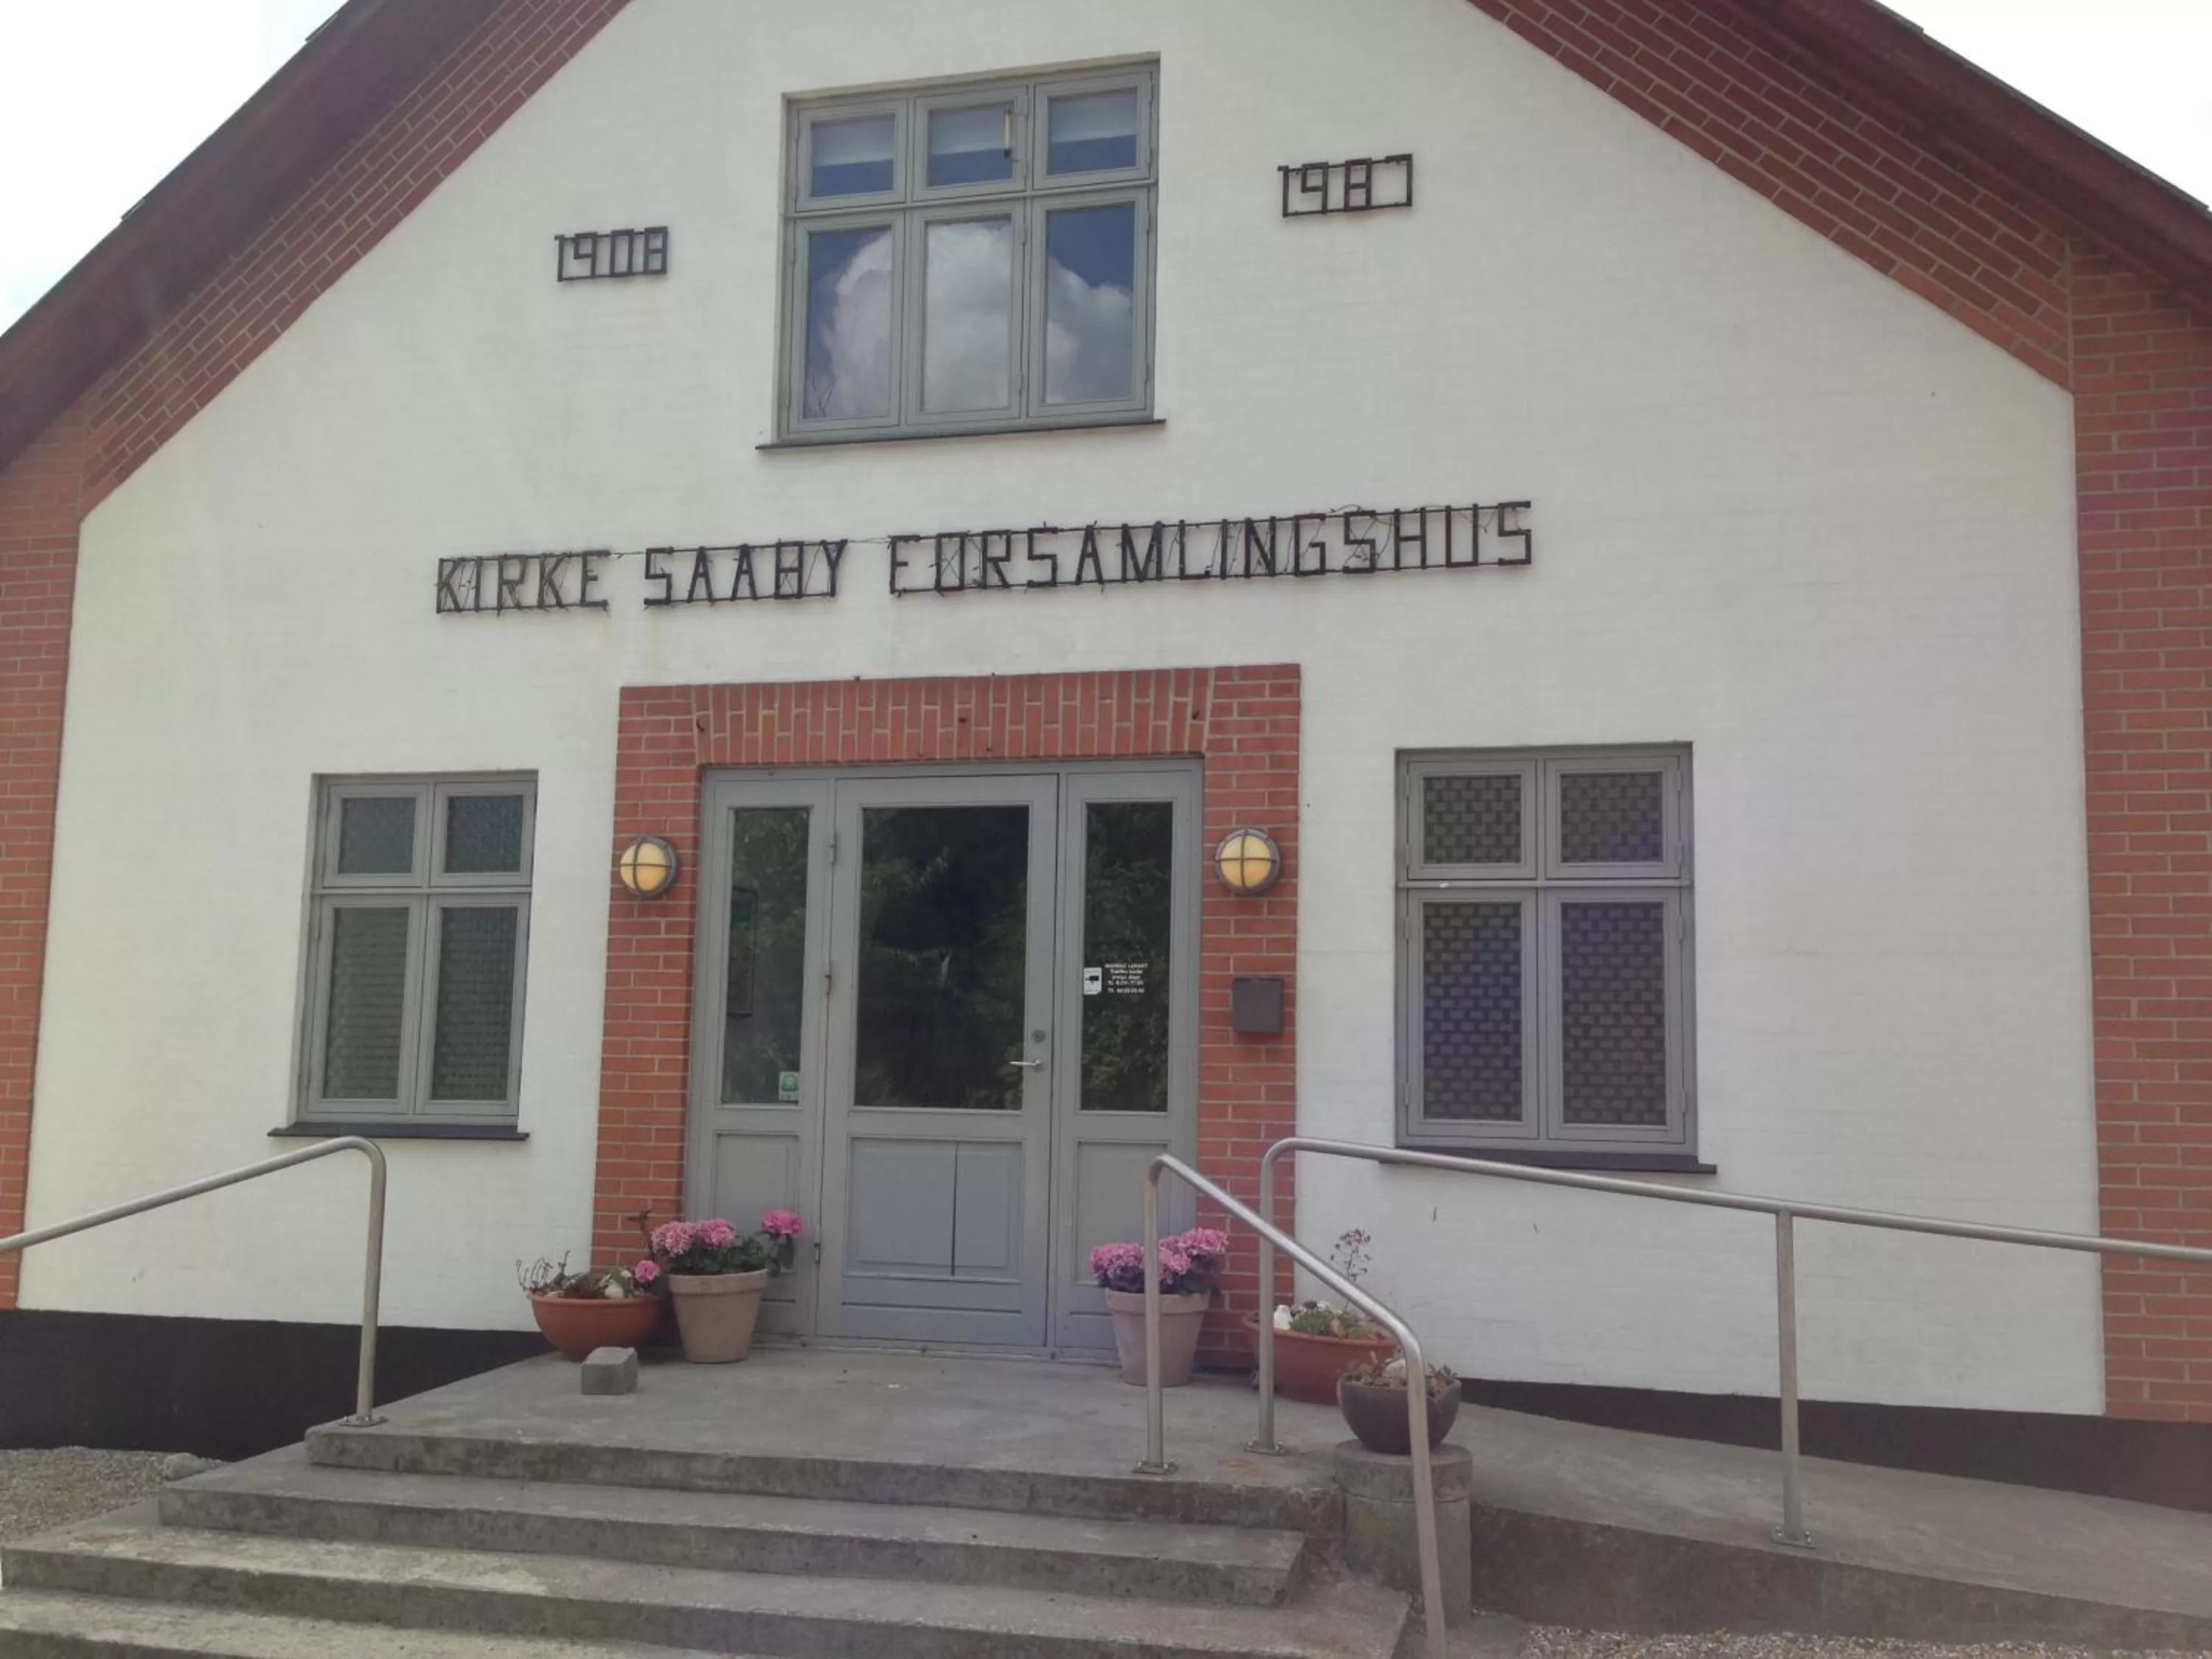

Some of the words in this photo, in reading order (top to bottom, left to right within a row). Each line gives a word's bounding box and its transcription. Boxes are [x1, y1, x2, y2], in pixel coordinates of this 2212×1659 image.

[1278, 153, 1413, 218] 1987
[554, 226, 668, 282] 1908
[437, 549, 611, 614] KIRKE
[644, 538, 848, 606] SAABY
[888, 501, 1531, 594] FORSAMLINGSHUS
